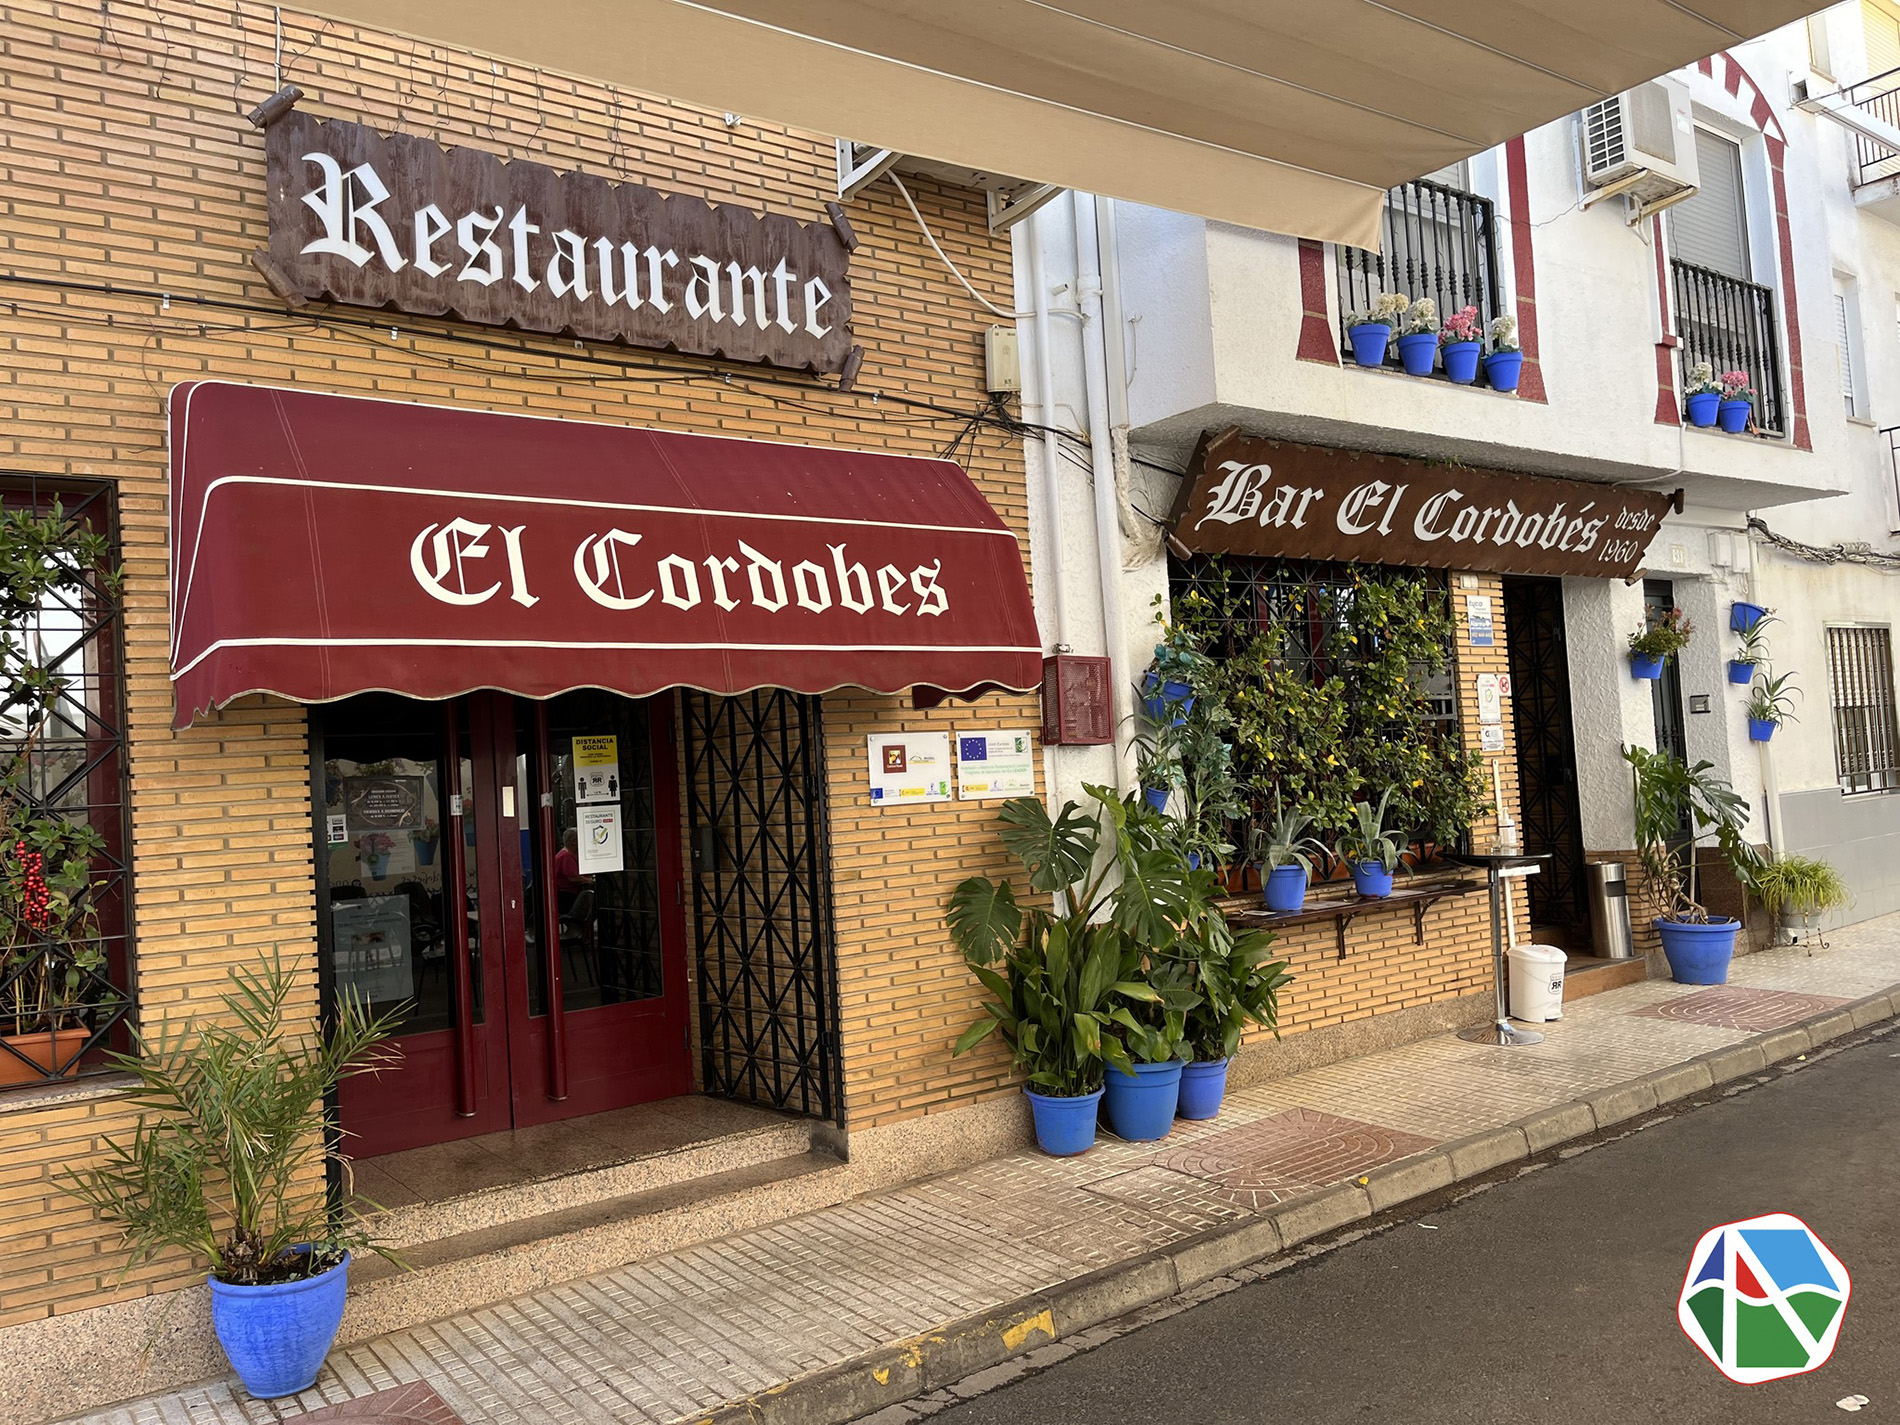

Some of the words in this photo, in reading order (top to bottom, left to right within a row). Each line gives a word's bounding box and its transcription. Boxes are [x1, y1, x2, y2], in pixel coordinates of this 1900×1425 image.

[299, 152, 834, 341] Restaurante
[1194, 460, 1325, 532] Bar
[1336, 479, 1409, 537] El
[1412, 488, 1610, 554] Cordobés
[1597, 537, 1639, 565] 1960
[1614, 505, 1656, 533] desde
[409, 516, 541, 609] El
[573, 527, 950, 617] Cordobes
